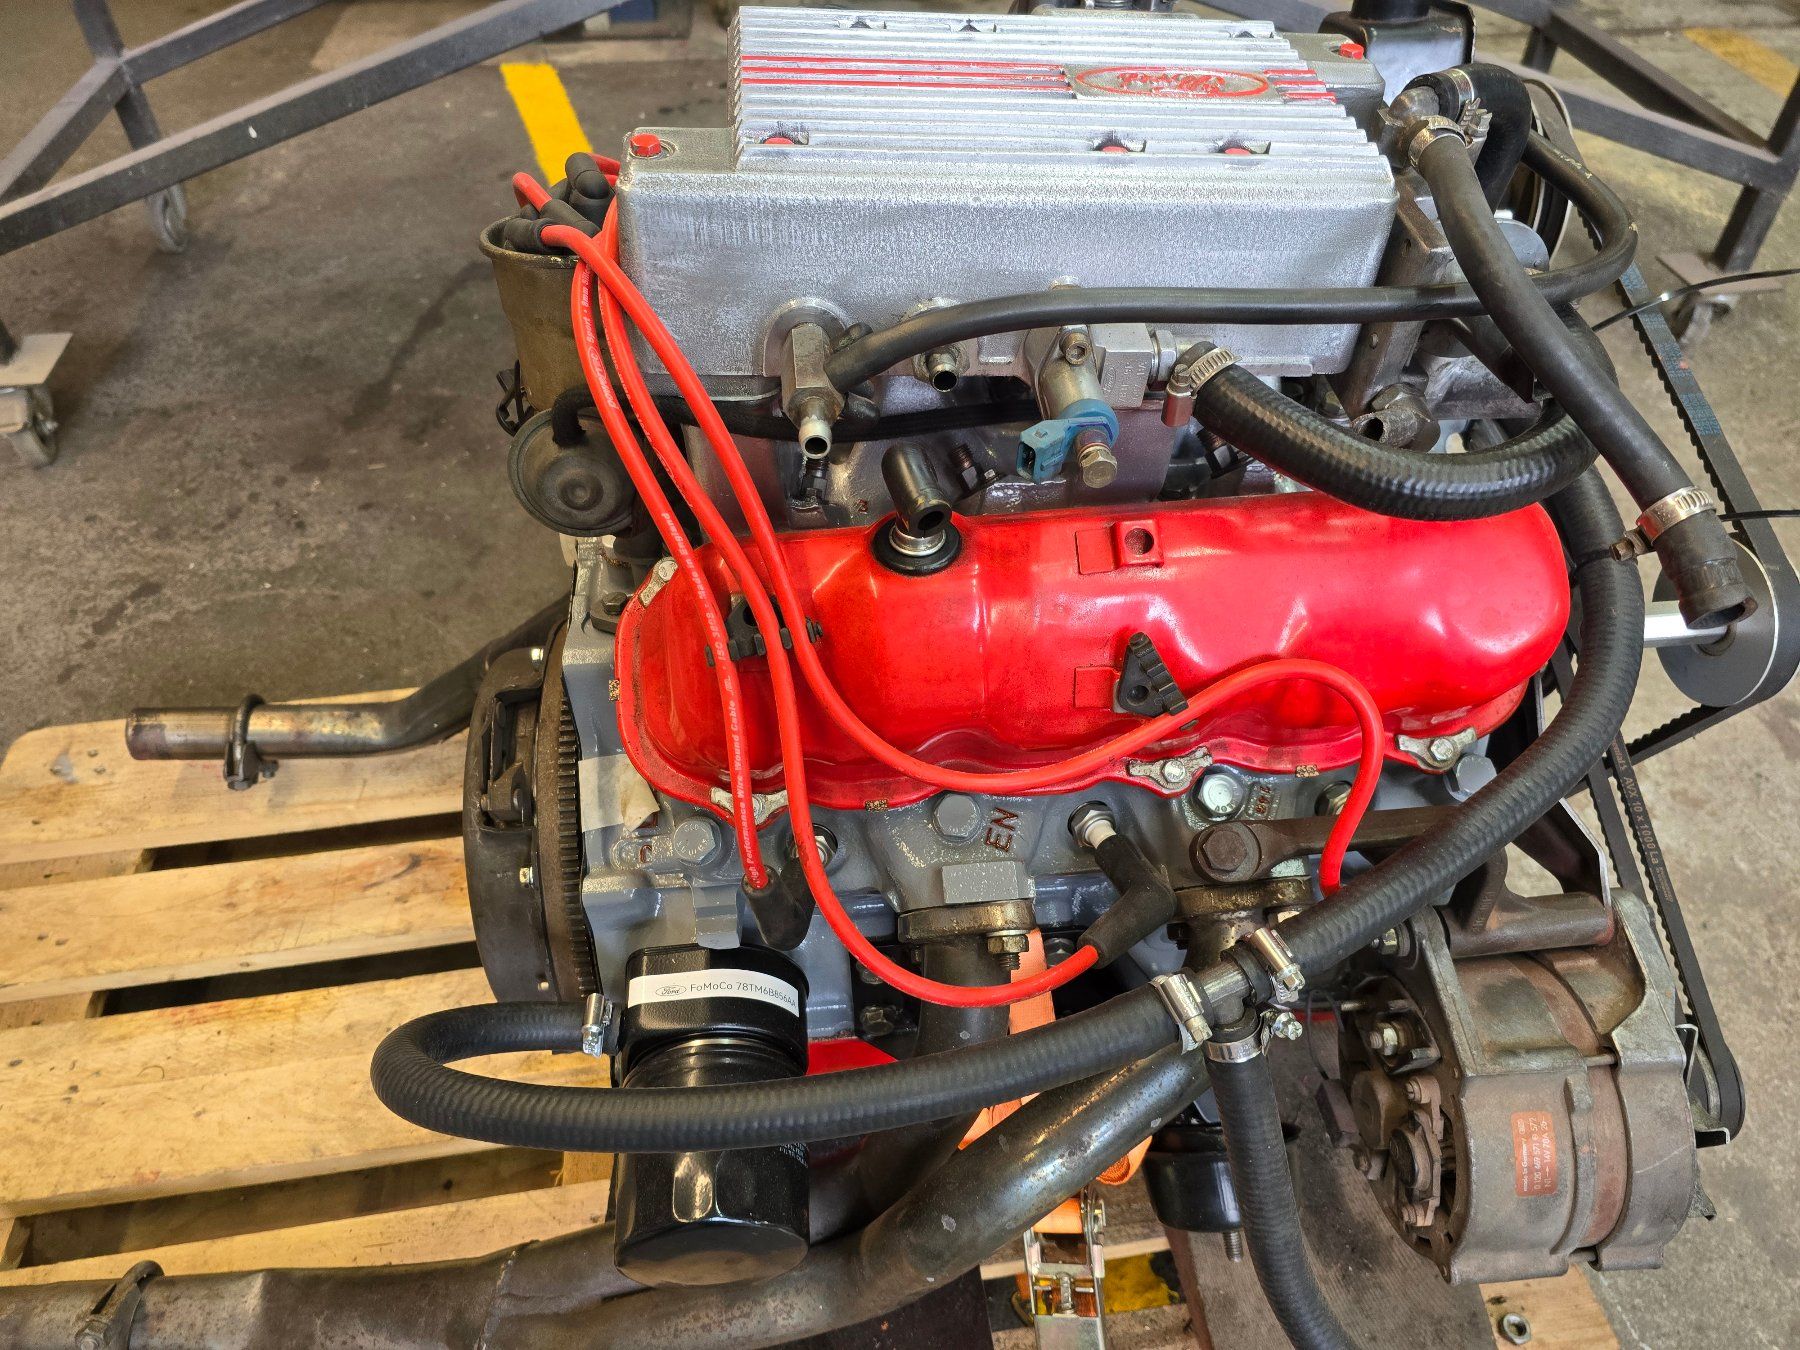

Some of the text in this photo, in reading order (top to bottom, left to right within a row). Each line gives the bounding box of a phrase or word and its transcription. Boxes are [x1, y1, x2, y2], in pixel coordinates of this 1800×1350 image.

[661, 512, 688, 556] England
[730, 700, 741, 732] Cable
[734, 734, 744, 771] Wound
[737, 774, 746, 798] Wire
[740, 802, 755, 865] Performance
[1623, 776, 1638, 799] AVX
[1631, 801, 1643, 813] 10
[1640, 824, 1655, 849] 1000
[1648, 850, 1659, 865] La
[689, 981, 734, 992] FoMoCo
